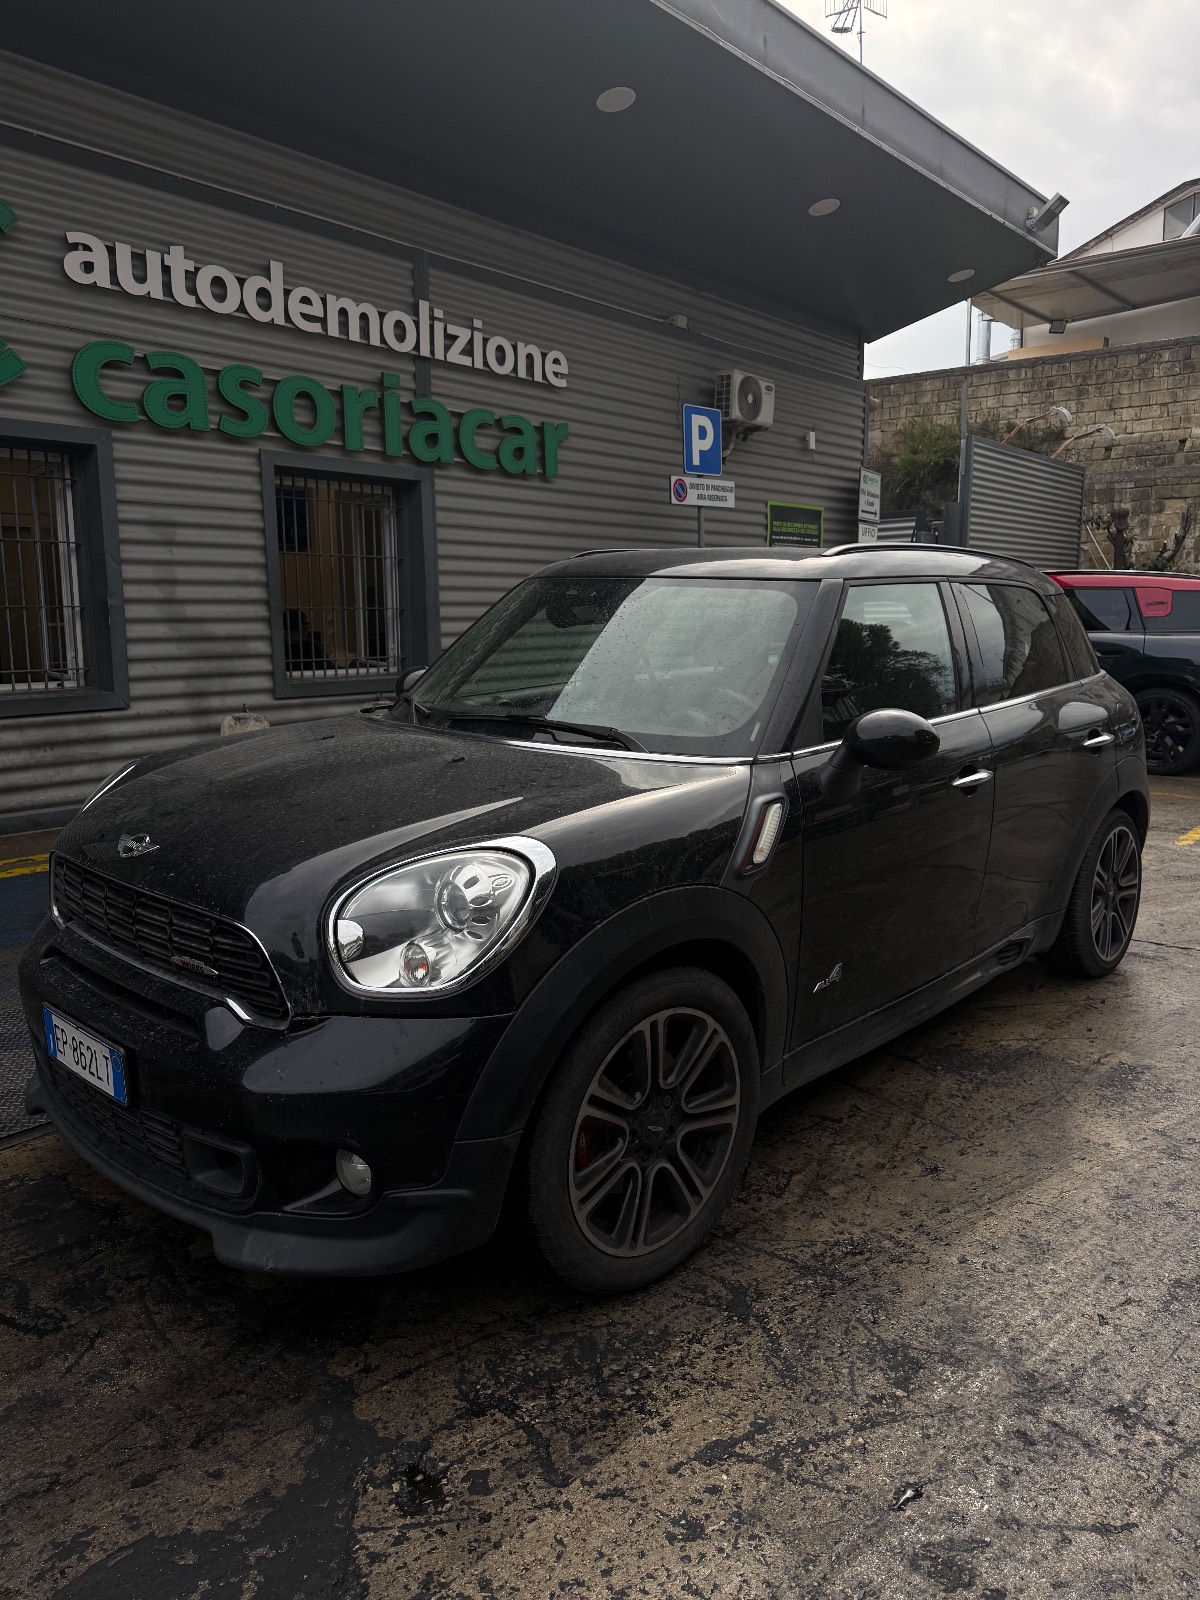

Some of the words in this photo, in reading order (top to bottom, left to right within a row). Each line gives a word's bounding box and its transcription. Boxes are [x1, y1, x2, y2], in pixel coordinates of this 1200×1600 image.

[63, 230, 569, 388] autodemolizione
[71, 340, 570, 479] casoriacar
[691, 414, 714, 466] P
[689, 482, 705, 491] DIVIETO
[711, 485, 734, 493] PARCHEGGIO
[862, 527, 876, 538] UFFICI
[53, 1023, 68, 1057] EP
[71, 1035, 111, 1086] 862LT
